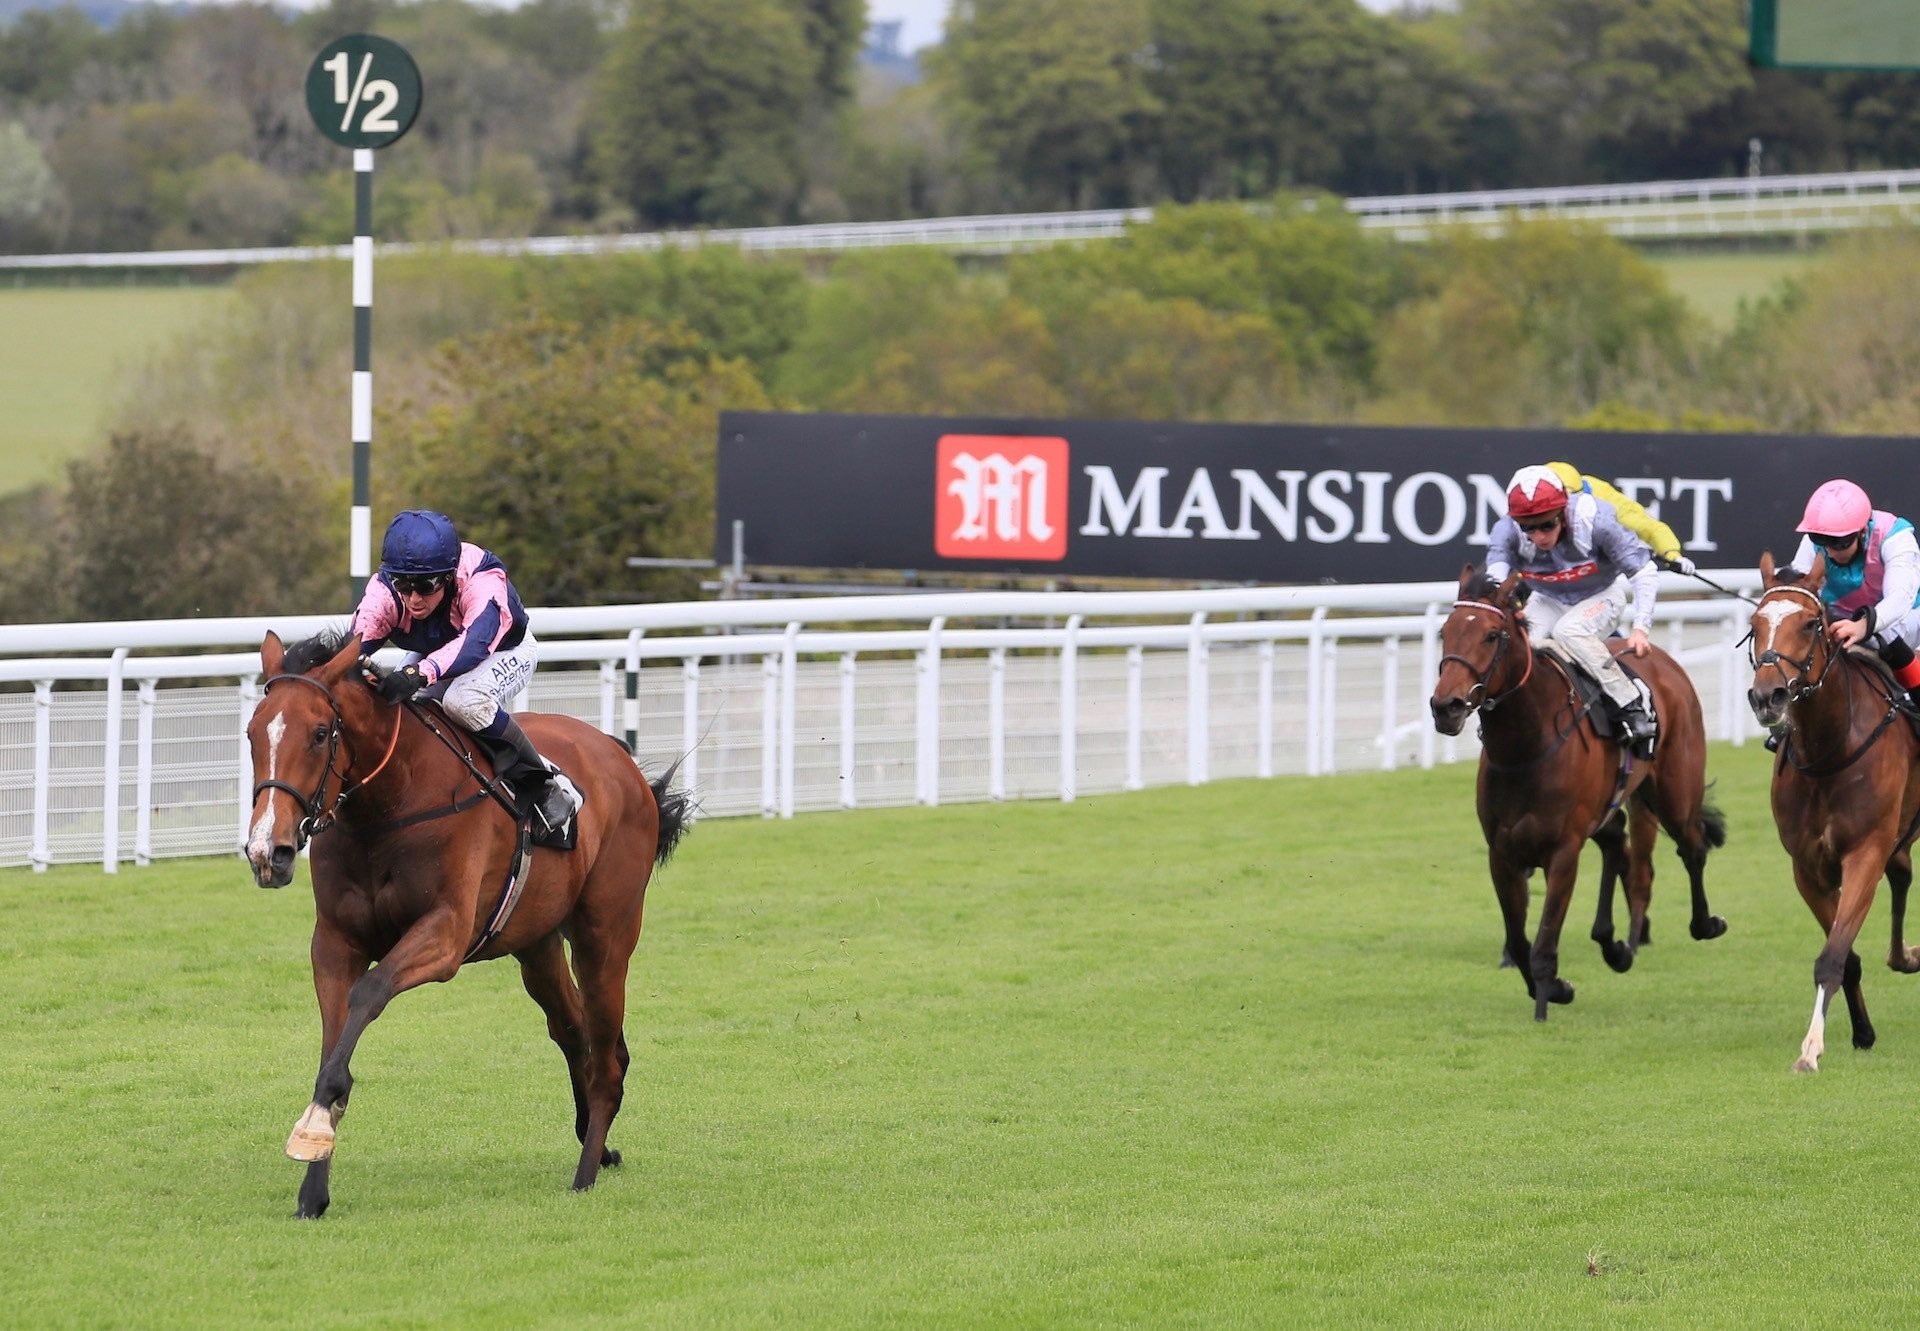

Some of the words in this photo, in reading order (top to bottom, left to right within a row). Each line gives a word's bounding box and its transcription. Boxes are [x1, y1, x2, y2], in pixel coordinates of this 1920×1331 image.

[323, 51, 399, 132] 1/2
[947, 452, 1055, 542] M
[1079, 465, 1733, 552] MANSIONT
[1524, 564, 1593, 583] ote
[491, 656, 518, 682] Alfa
